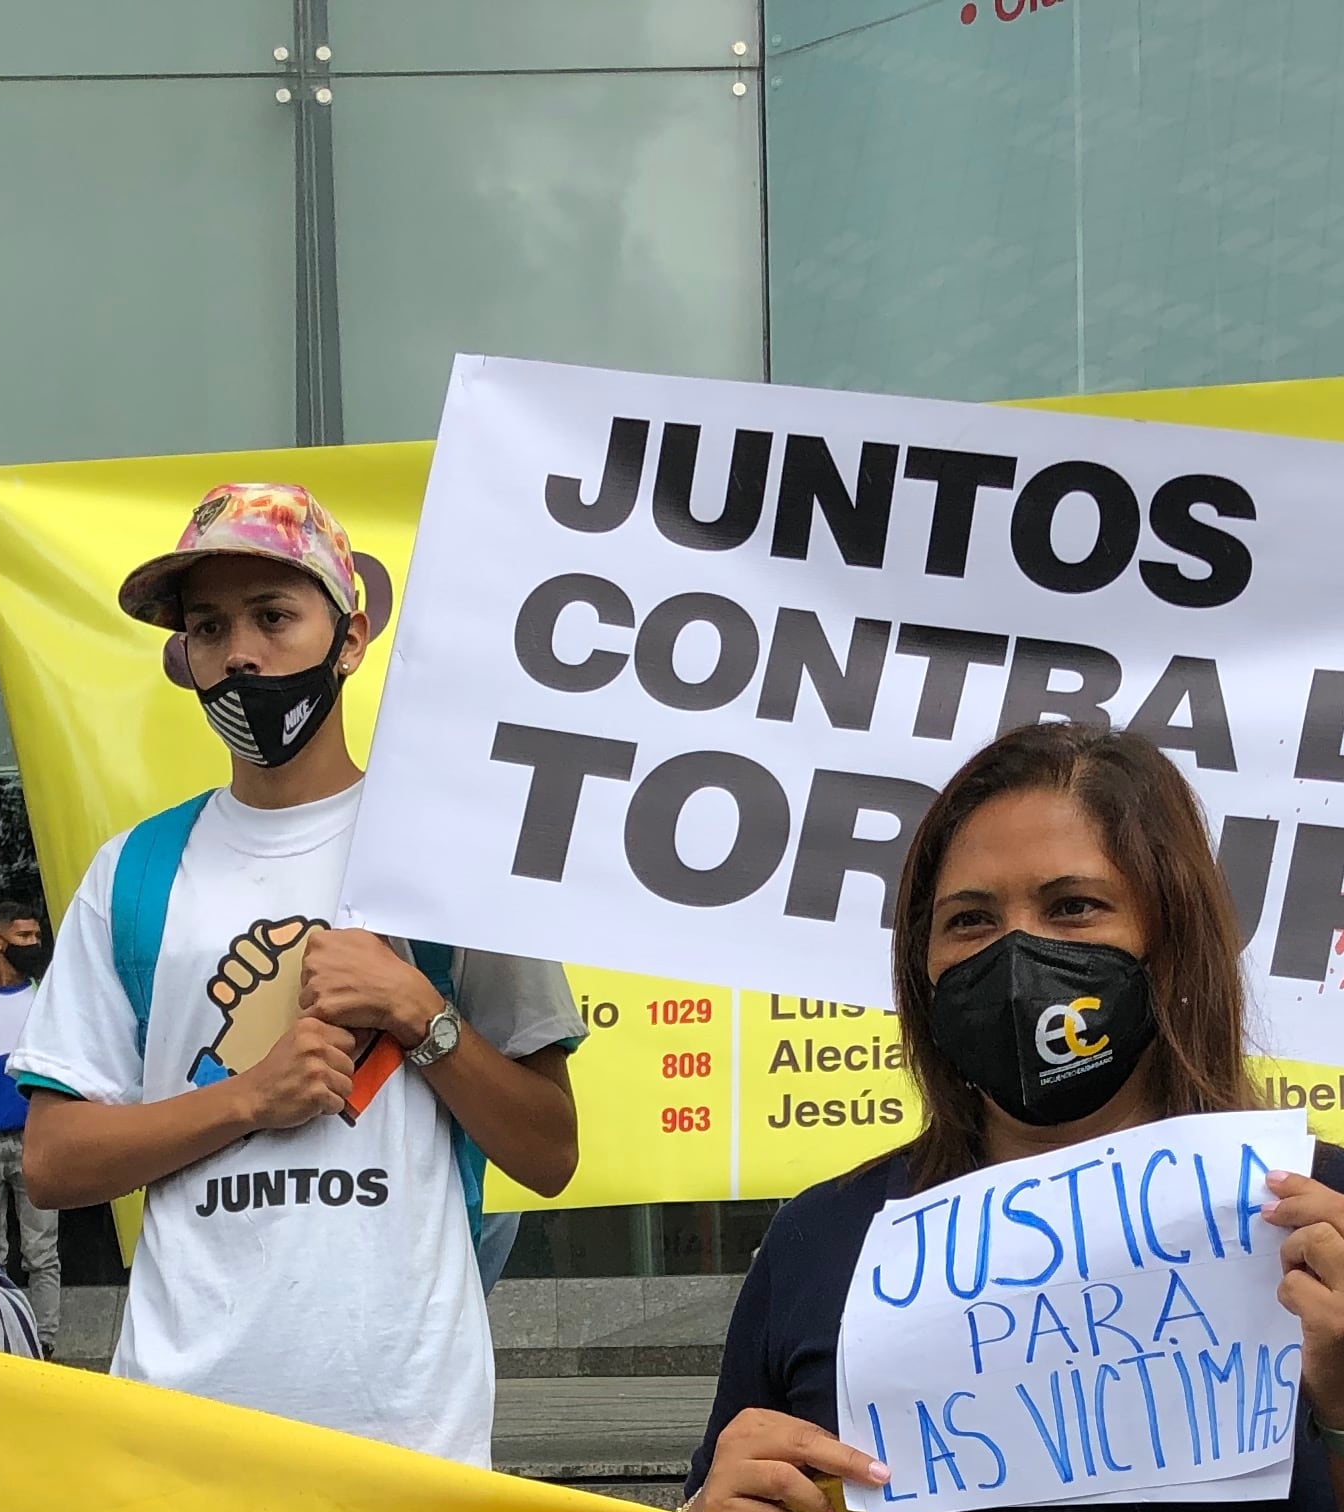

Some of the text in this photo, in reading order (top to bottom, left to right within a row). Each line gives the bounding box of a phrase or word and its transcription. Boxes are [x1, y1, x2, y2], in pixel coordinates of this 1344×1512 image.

[545, 416, 1257, 608] JUNTOS
[514, 572, 1238, 773] CONTRA
[284, 697, 311, 732] NIKE
[646, 998, 713, 1027] 1029
[661, 1037, 905, 1080] 808 Alecia
[661, 1090, 905, 1134] 963 Jesús
[194, 1167, 389, 1219] JUNTOS
[872, 1143, 1273, 1309] JUSTICIA
[964, 1268, 1219, 1375] PARA
[867, 1391, 1008, 1503] LAS
